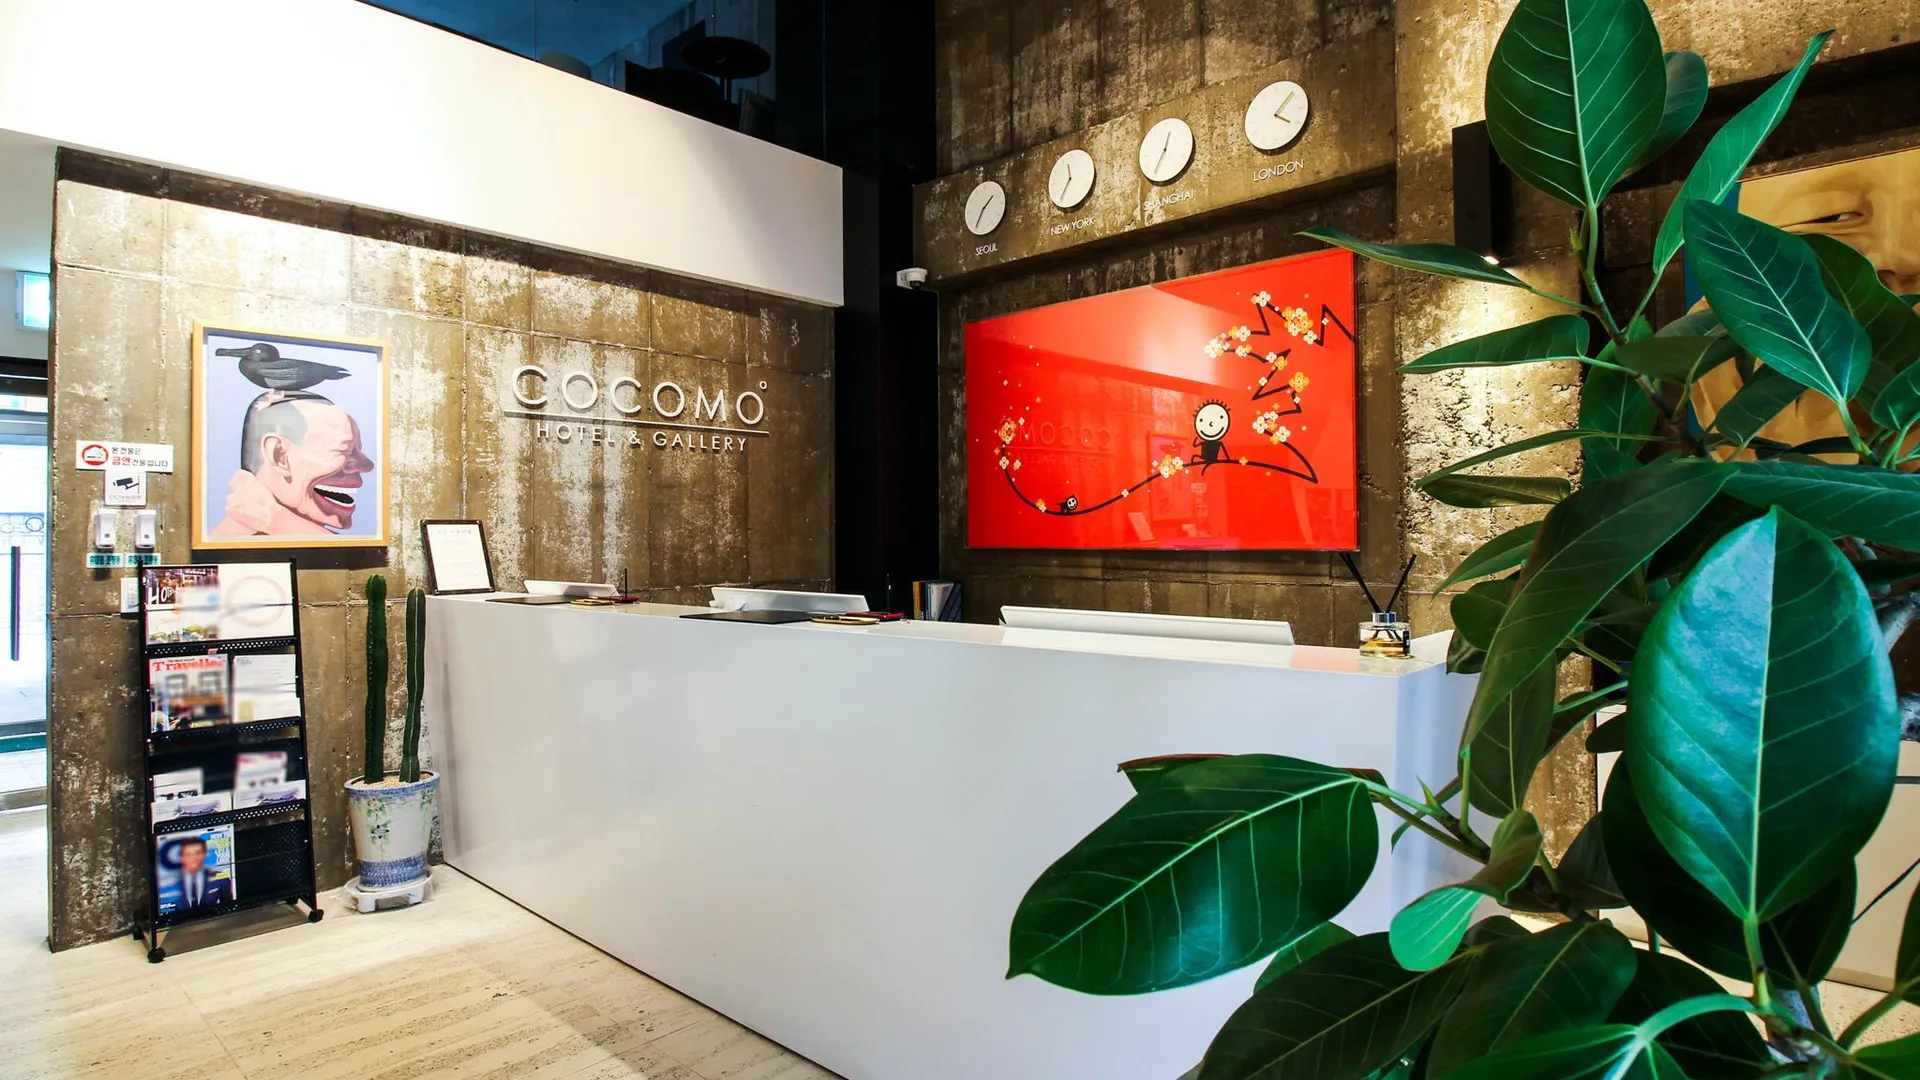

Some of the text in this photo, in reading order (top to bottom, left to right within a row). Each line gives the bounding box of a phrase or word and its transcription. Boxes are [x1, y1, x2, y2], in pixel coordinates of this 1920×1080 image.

[1253, 158, 1305, 182] LONDON
[1143, 189, 1195, 212] SHANGHAI
[1050, 216, 1096, 236] NEW YORK
[975, 242, 998, 257] SEOUL
[536, 422, 747, 453] HOTEL & GALLERY
